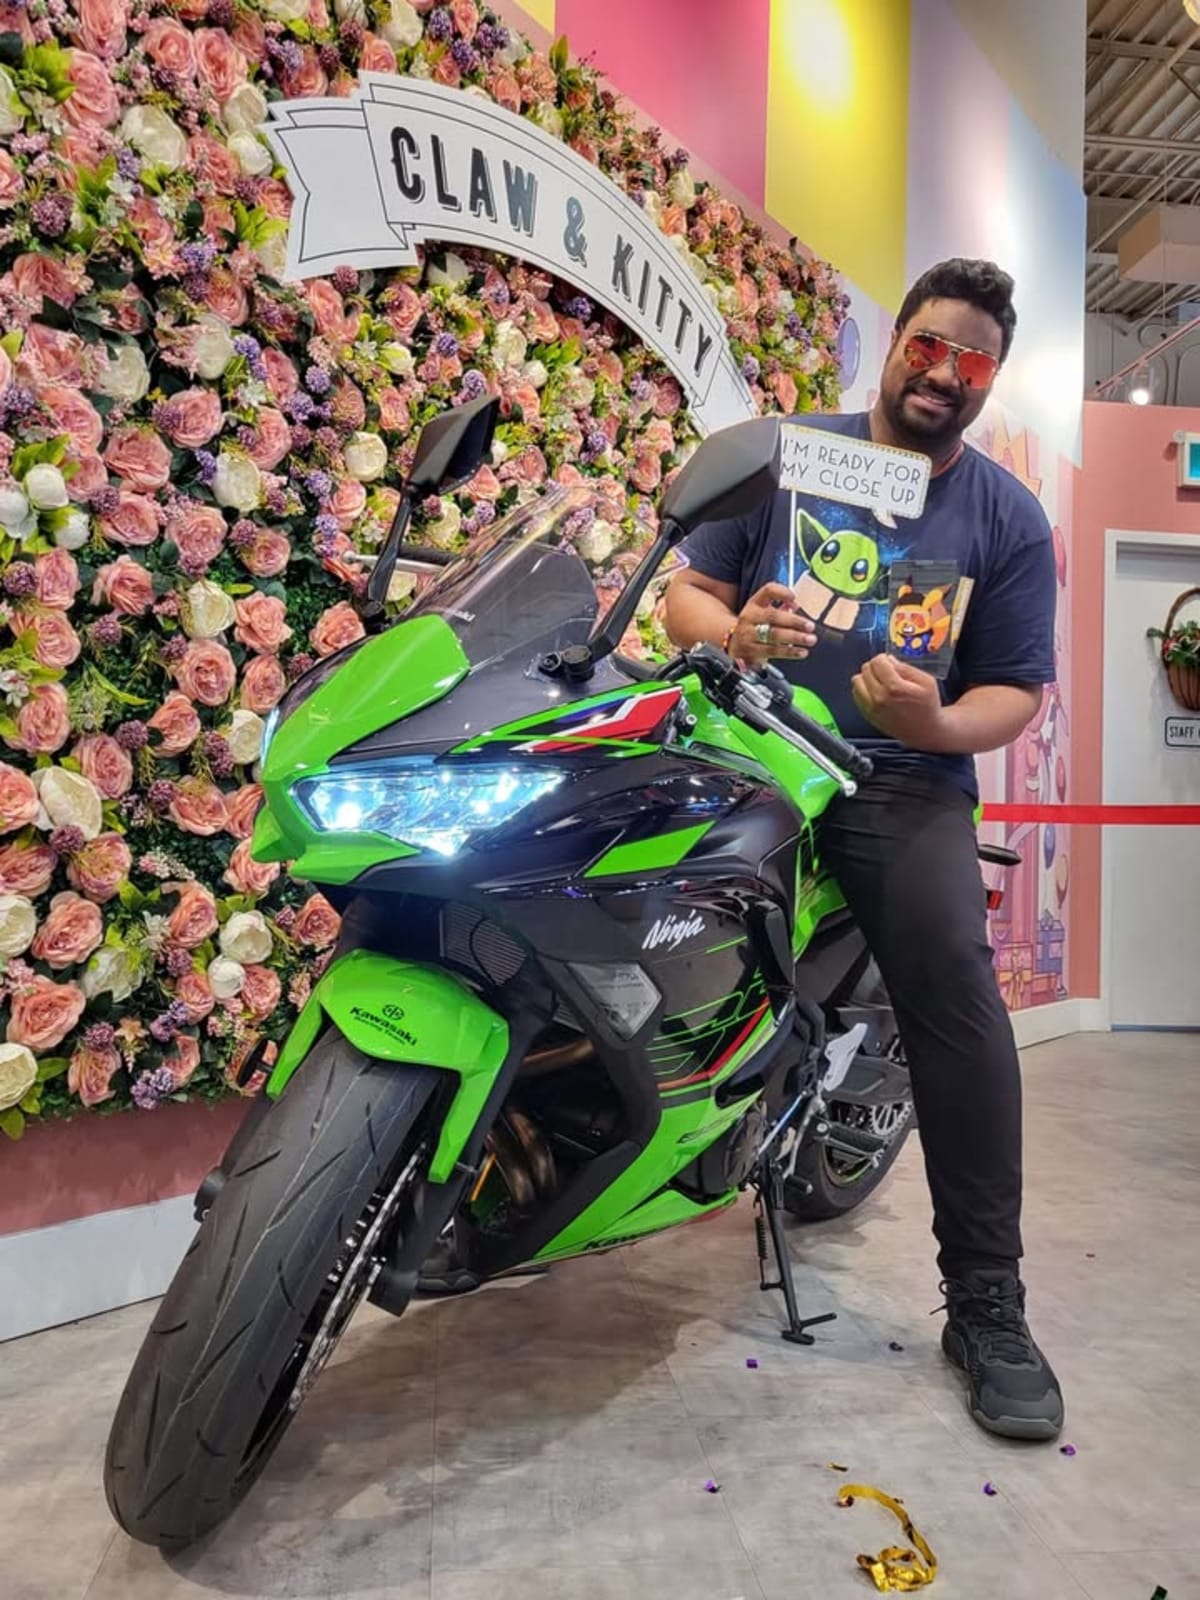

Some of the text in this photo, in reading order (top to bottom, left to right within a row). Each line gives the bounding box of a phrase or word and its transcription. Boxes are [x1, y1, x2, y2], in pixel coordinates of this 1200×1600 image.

[389, 126, 713, 378] CLAW & KITTY
[780, 461, 915, 504] MY CLOSE UP
[783, 439, 920, 485] I'M READY FOR
[1169, 726, 1195, 739] STAFF
[641, 909, 706, 952] Ninja
[350, 1006, 417, 1046] Kawasaki
